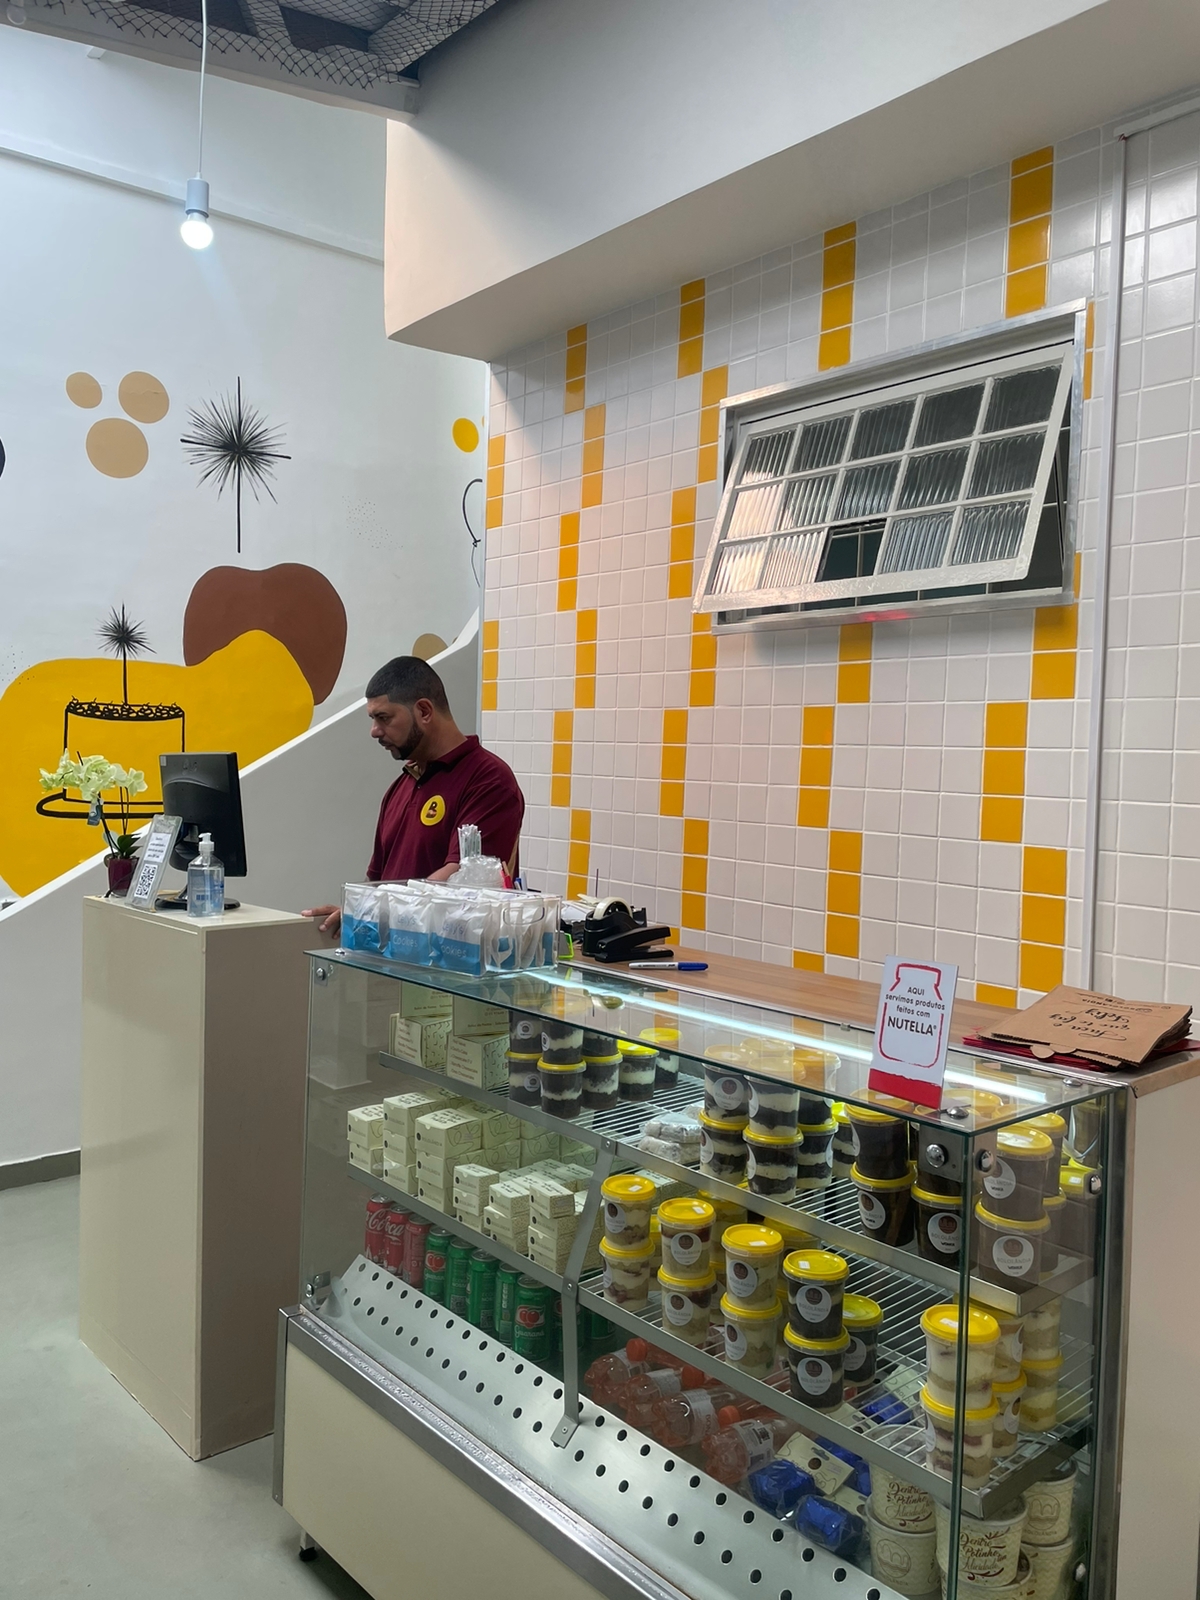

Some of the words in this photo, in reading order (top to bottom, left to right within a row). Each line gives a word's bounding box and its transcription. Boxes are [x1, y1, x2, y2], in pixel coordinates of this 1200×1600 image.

[392, 934, 419, 949] Cookies
[441, 944, 467, 959] ookies
[907, 986, 925, 996] AQUI
[885, 993, 914, 1005] servimos
[915, 999, 945, 1011] produtos
[896, 1004, 915, 1016] feitos
[916, 1009, 931, 1019] com
[960, 1533, 993, 1549] Dentro
[963, 1545, 999, 1559] Potinho
